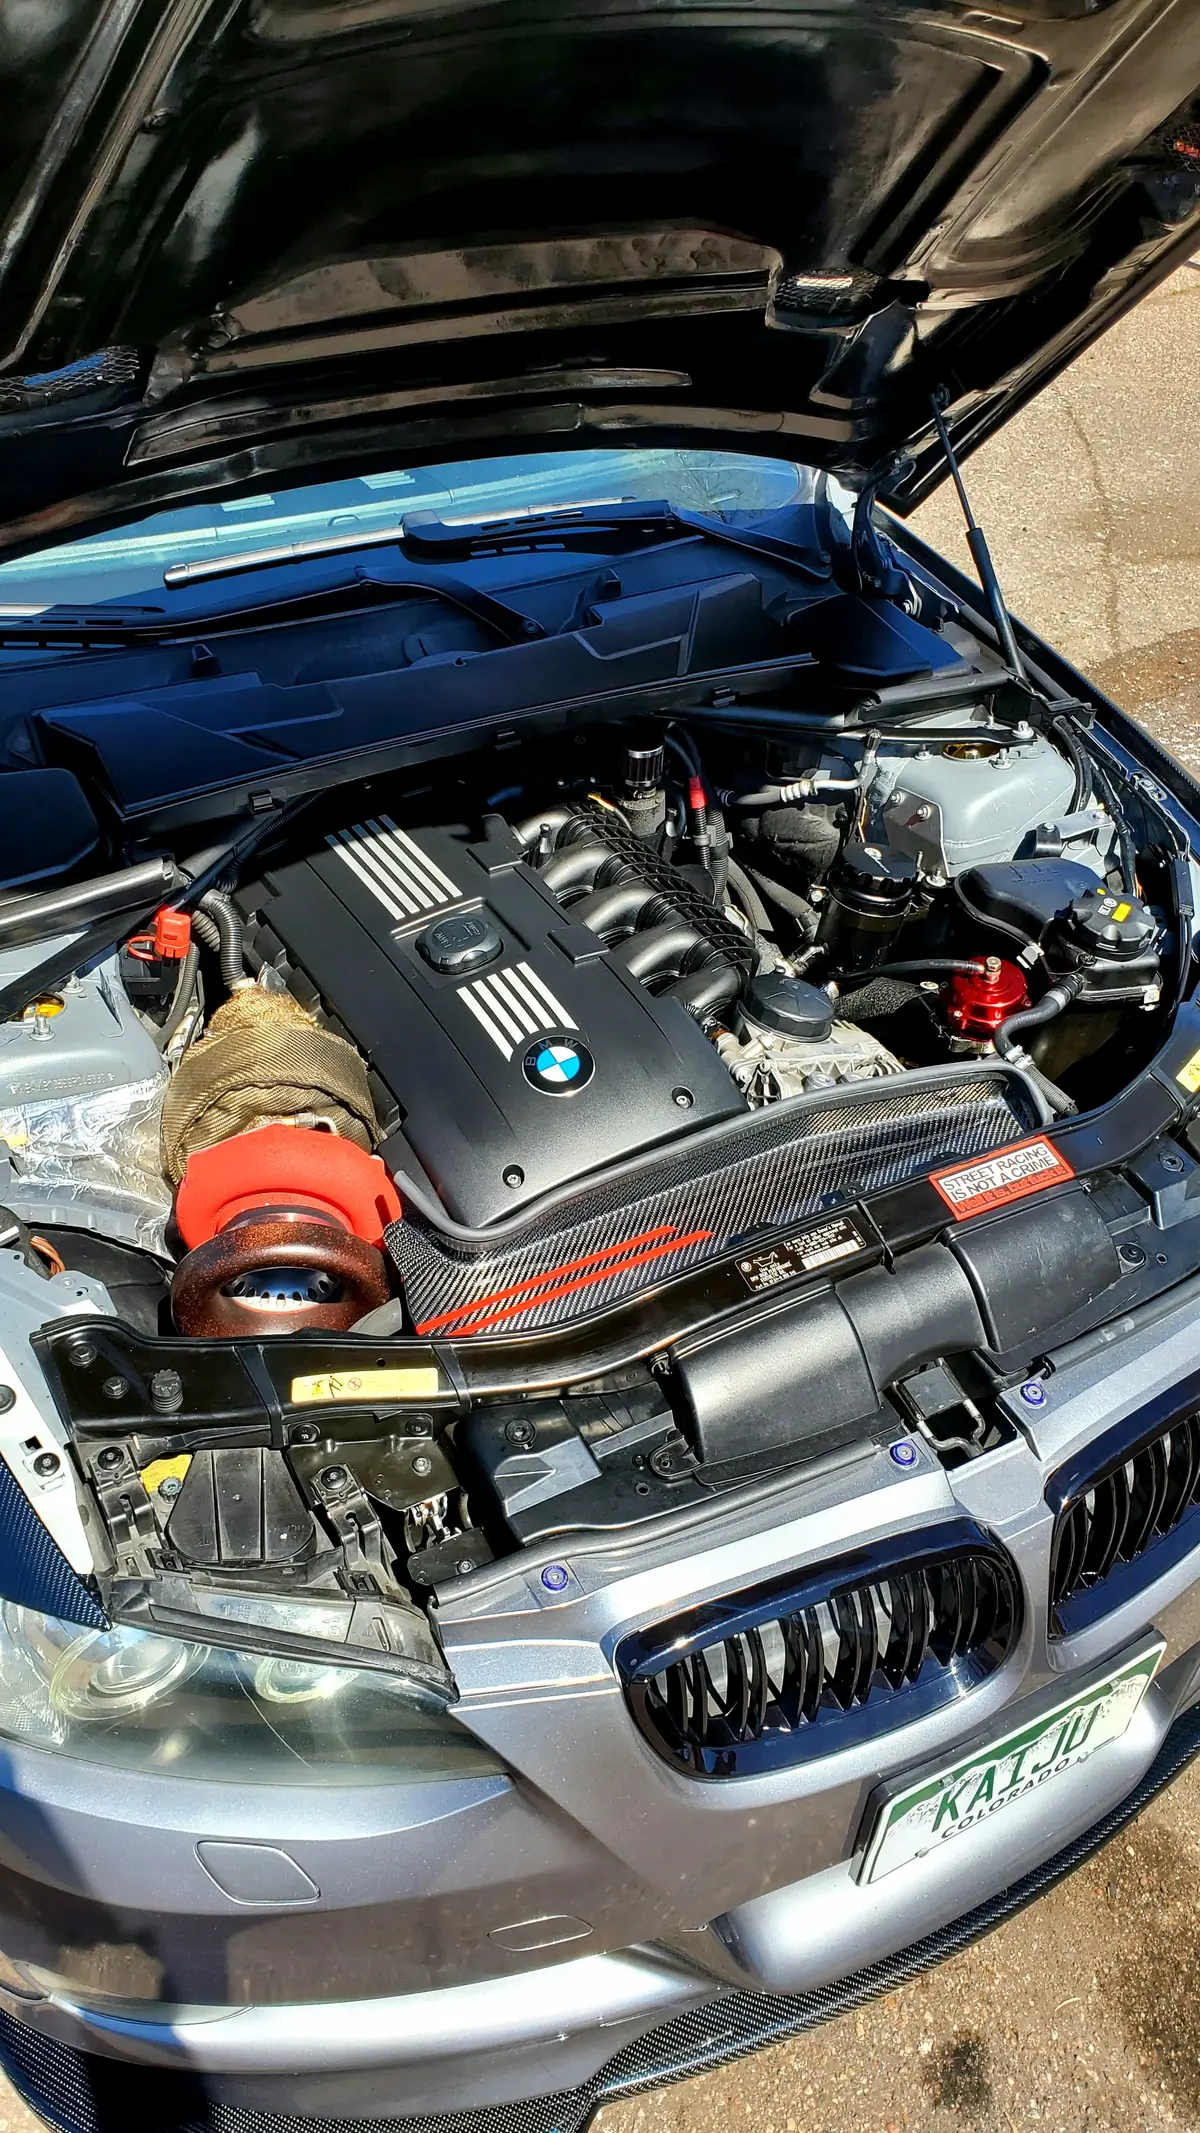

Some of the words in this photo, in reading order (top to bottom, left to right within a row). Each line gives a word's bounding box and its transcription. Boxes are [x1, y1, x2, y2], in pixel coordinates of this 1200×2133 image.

[525, 1038, 579, 1066] BMW
[943, 1164, 994, 1191] STREET
[996, 1146, 1048, 1171] RACING
[950, 1188, 967, 1201] IS
[967, 1177, 997, 1195] NOT
[1001, 1172, 1010, 1183] A
[1011, 1155, 1056, 1178] CRIME
[954, 1195, 985, 1212] Well
[1028, 1170, 1054, 1185] fuck
[931, 1703, 1101, 1833] KAIJU
[941, 1757, 1070, 1839] COLORADO
